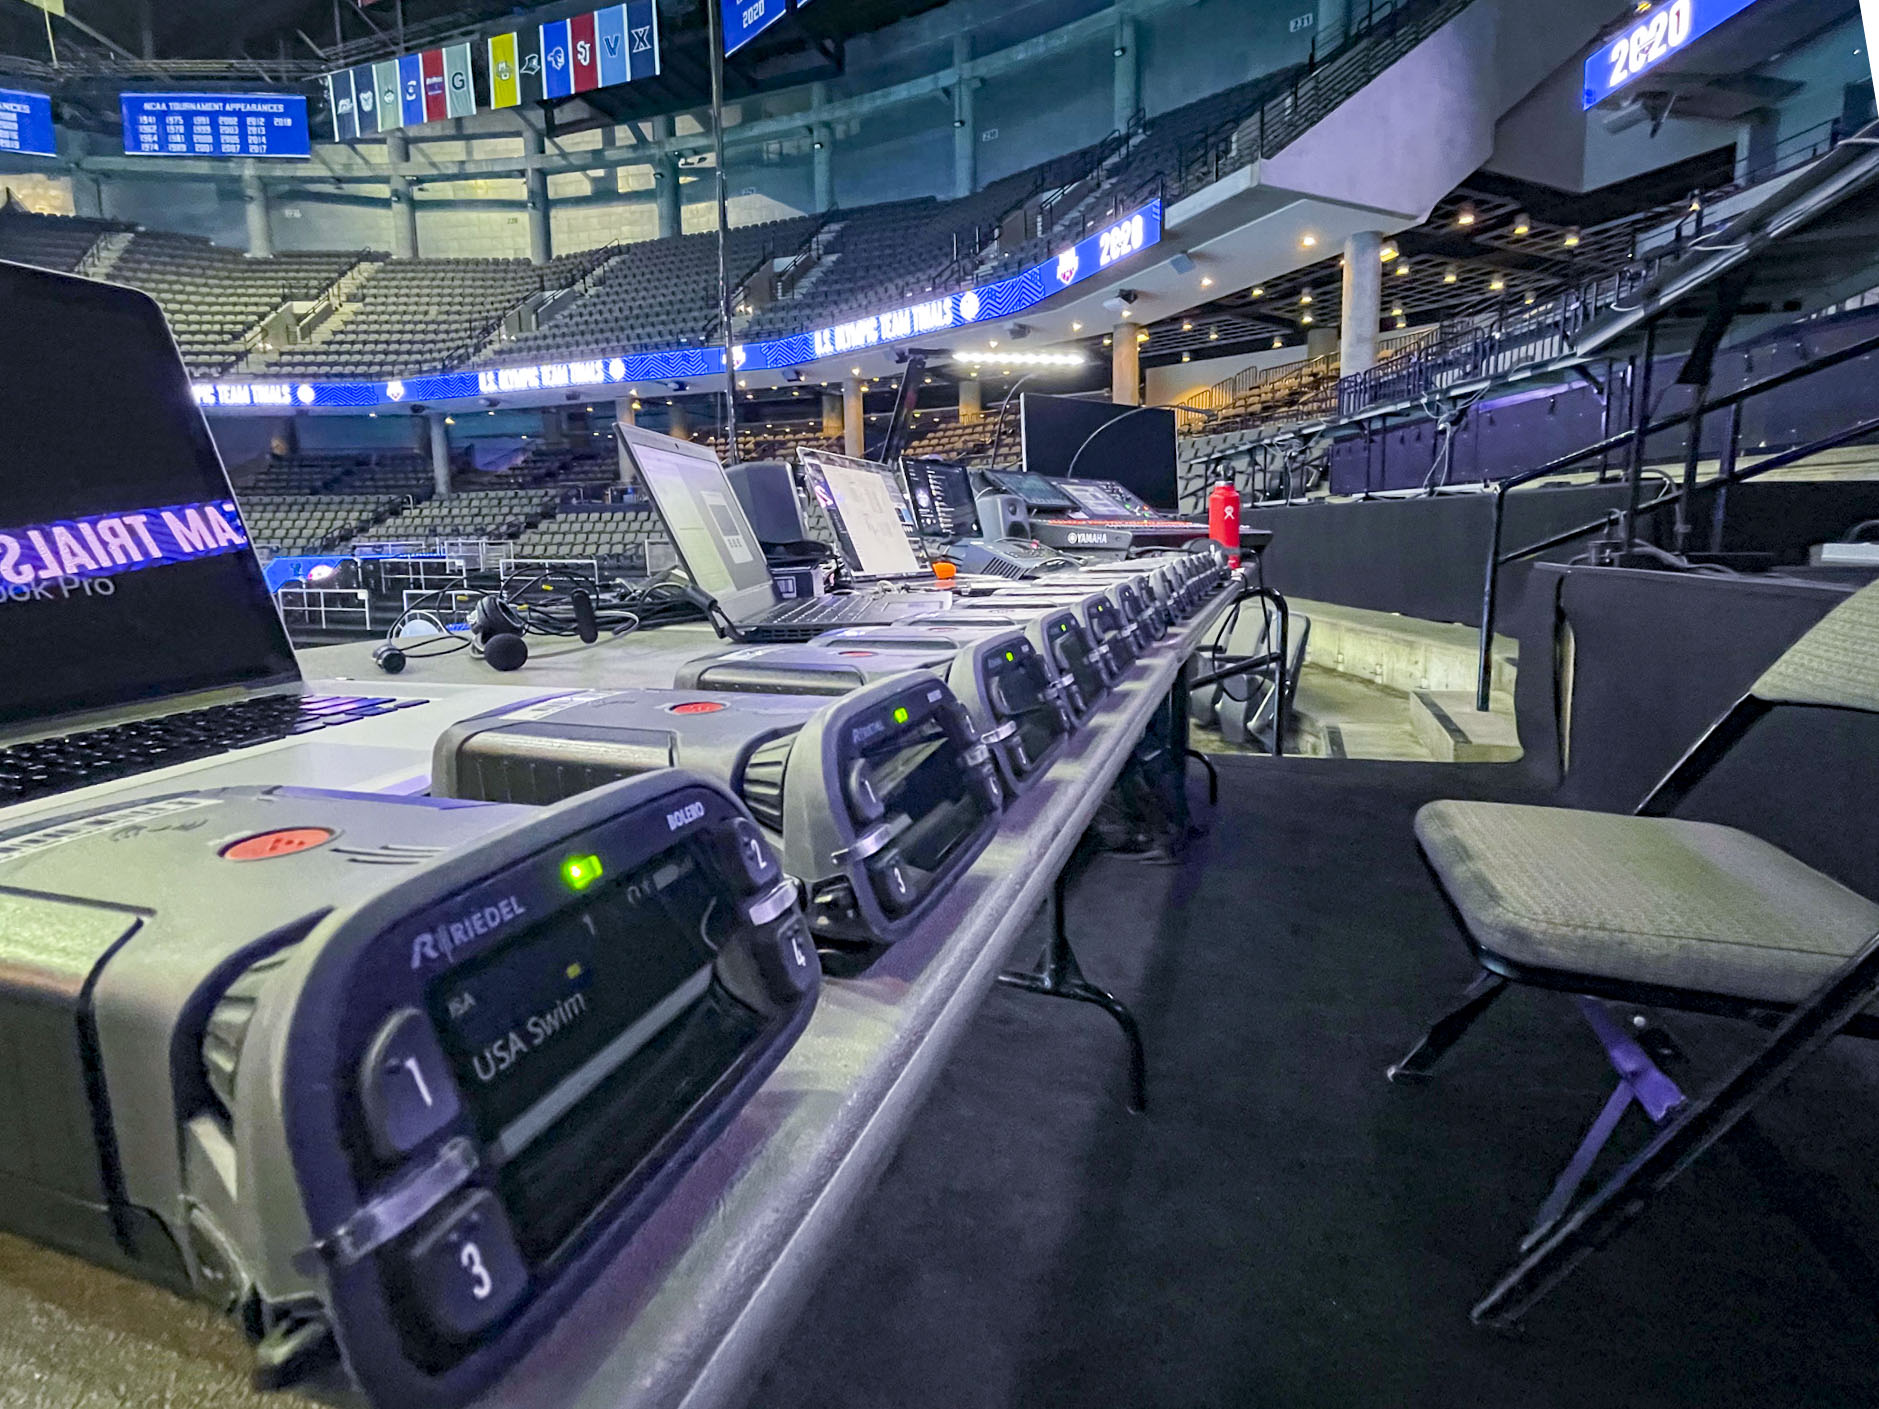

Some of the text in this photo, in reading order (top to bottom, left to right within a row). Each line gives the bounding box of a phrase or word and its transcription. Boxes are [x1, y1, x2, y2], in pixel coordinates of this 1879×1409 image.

[742, 1, 765, 29] 2020
[603, 34, 621, 58] V
[1608, 0, 1691, 88] 2020
[452, 72, 465, 91] G
[143, 102, 285, 113] NCAA TOURNAMENT APPEARANCES
[1100, 214, 1143, 266] 2020
[879, 307, 914, 340] TEAM
[911, 295, 953, 333] TRIALS
[540, 363, 569, 388] TEAM
[570, 359, 604, 385] TRIALS
[216, 384, 251, 404] TEAM
[250, 384, 292, 405] TRIALS
[1077, 533, 1107, 544] YAMAHA
[58, 576, 116, 598] Pro
[666, 801, 705, 831] BOLERO
[750, 839, 767, 869] 2
[450, 896, 526, 946] RIEDEL
[791, 937, 806, 967] 4
[473, 992, 587, 1080] USA Swim
[404, 1057, 432, 1107] 1
[460, 1242, 492, 1299] 3
